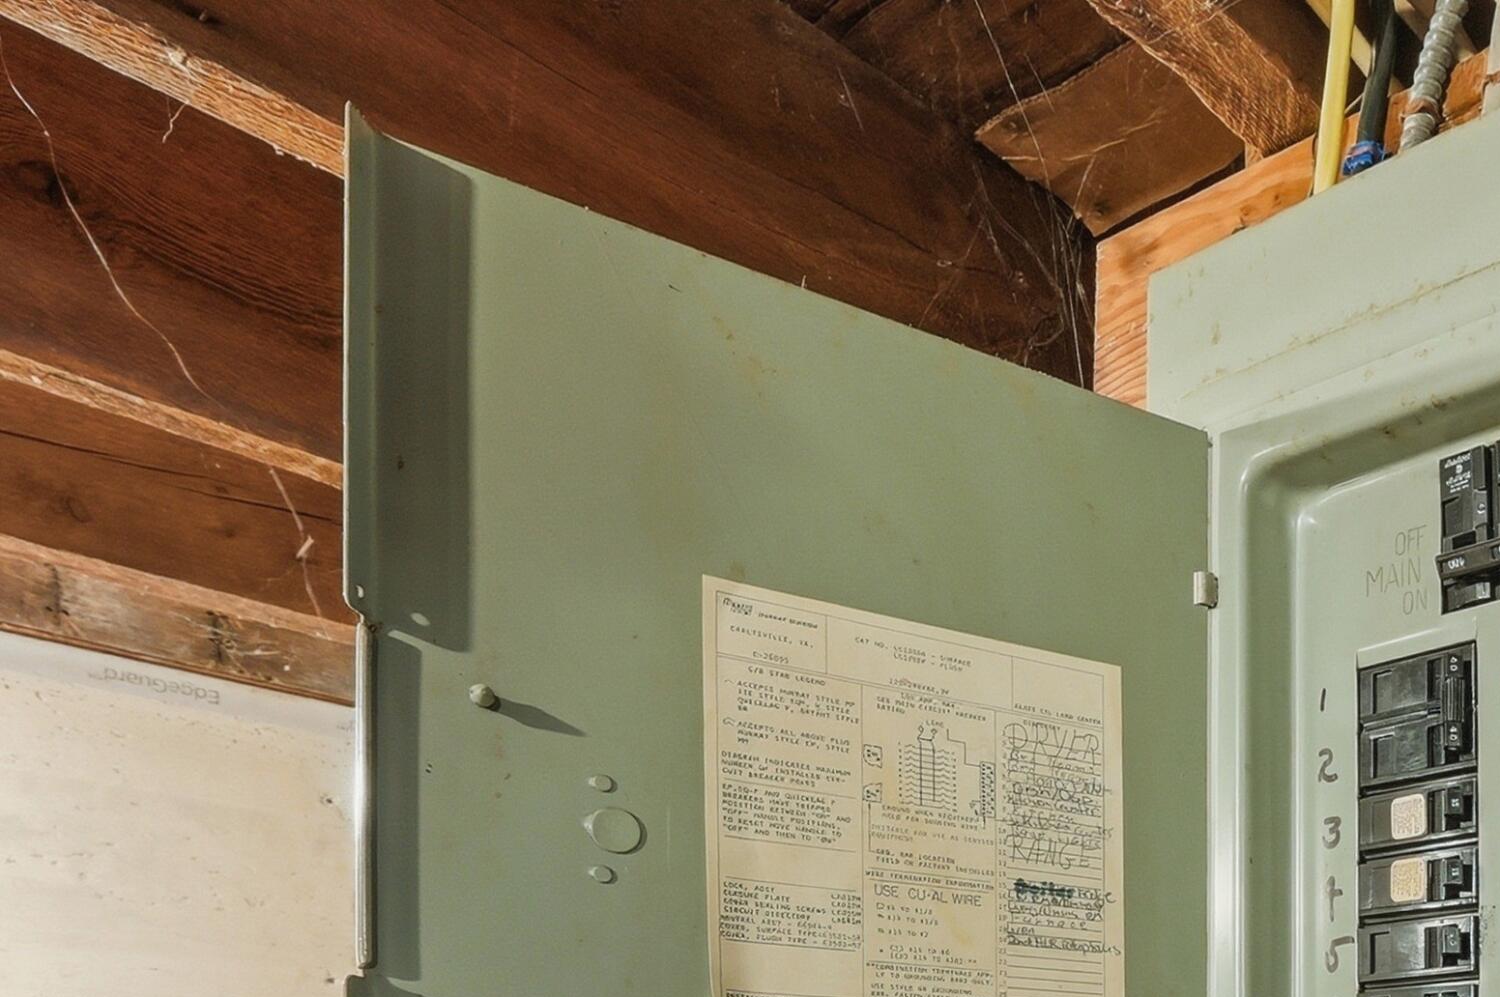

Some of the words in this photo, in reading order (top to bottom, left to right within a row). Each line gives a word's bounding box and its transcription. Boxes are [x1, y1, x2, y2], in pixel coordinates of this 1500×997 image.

[1394, 524, 1427, 556] OFF
[1366, 557, 1422, 597] MAIN
[1402, 589, 1428, 615] ON
[1319, 687, 1327, 713] 1
[1318, 748, 1339, 784] 2
[1322, 816, 1342, 850] 3
[873, 883, 900, 898] USE
[951, 892, 983, 907] WIRE
[1323, 875, 1344, 922] 4
[1325, 935, 1355, 975] 5
